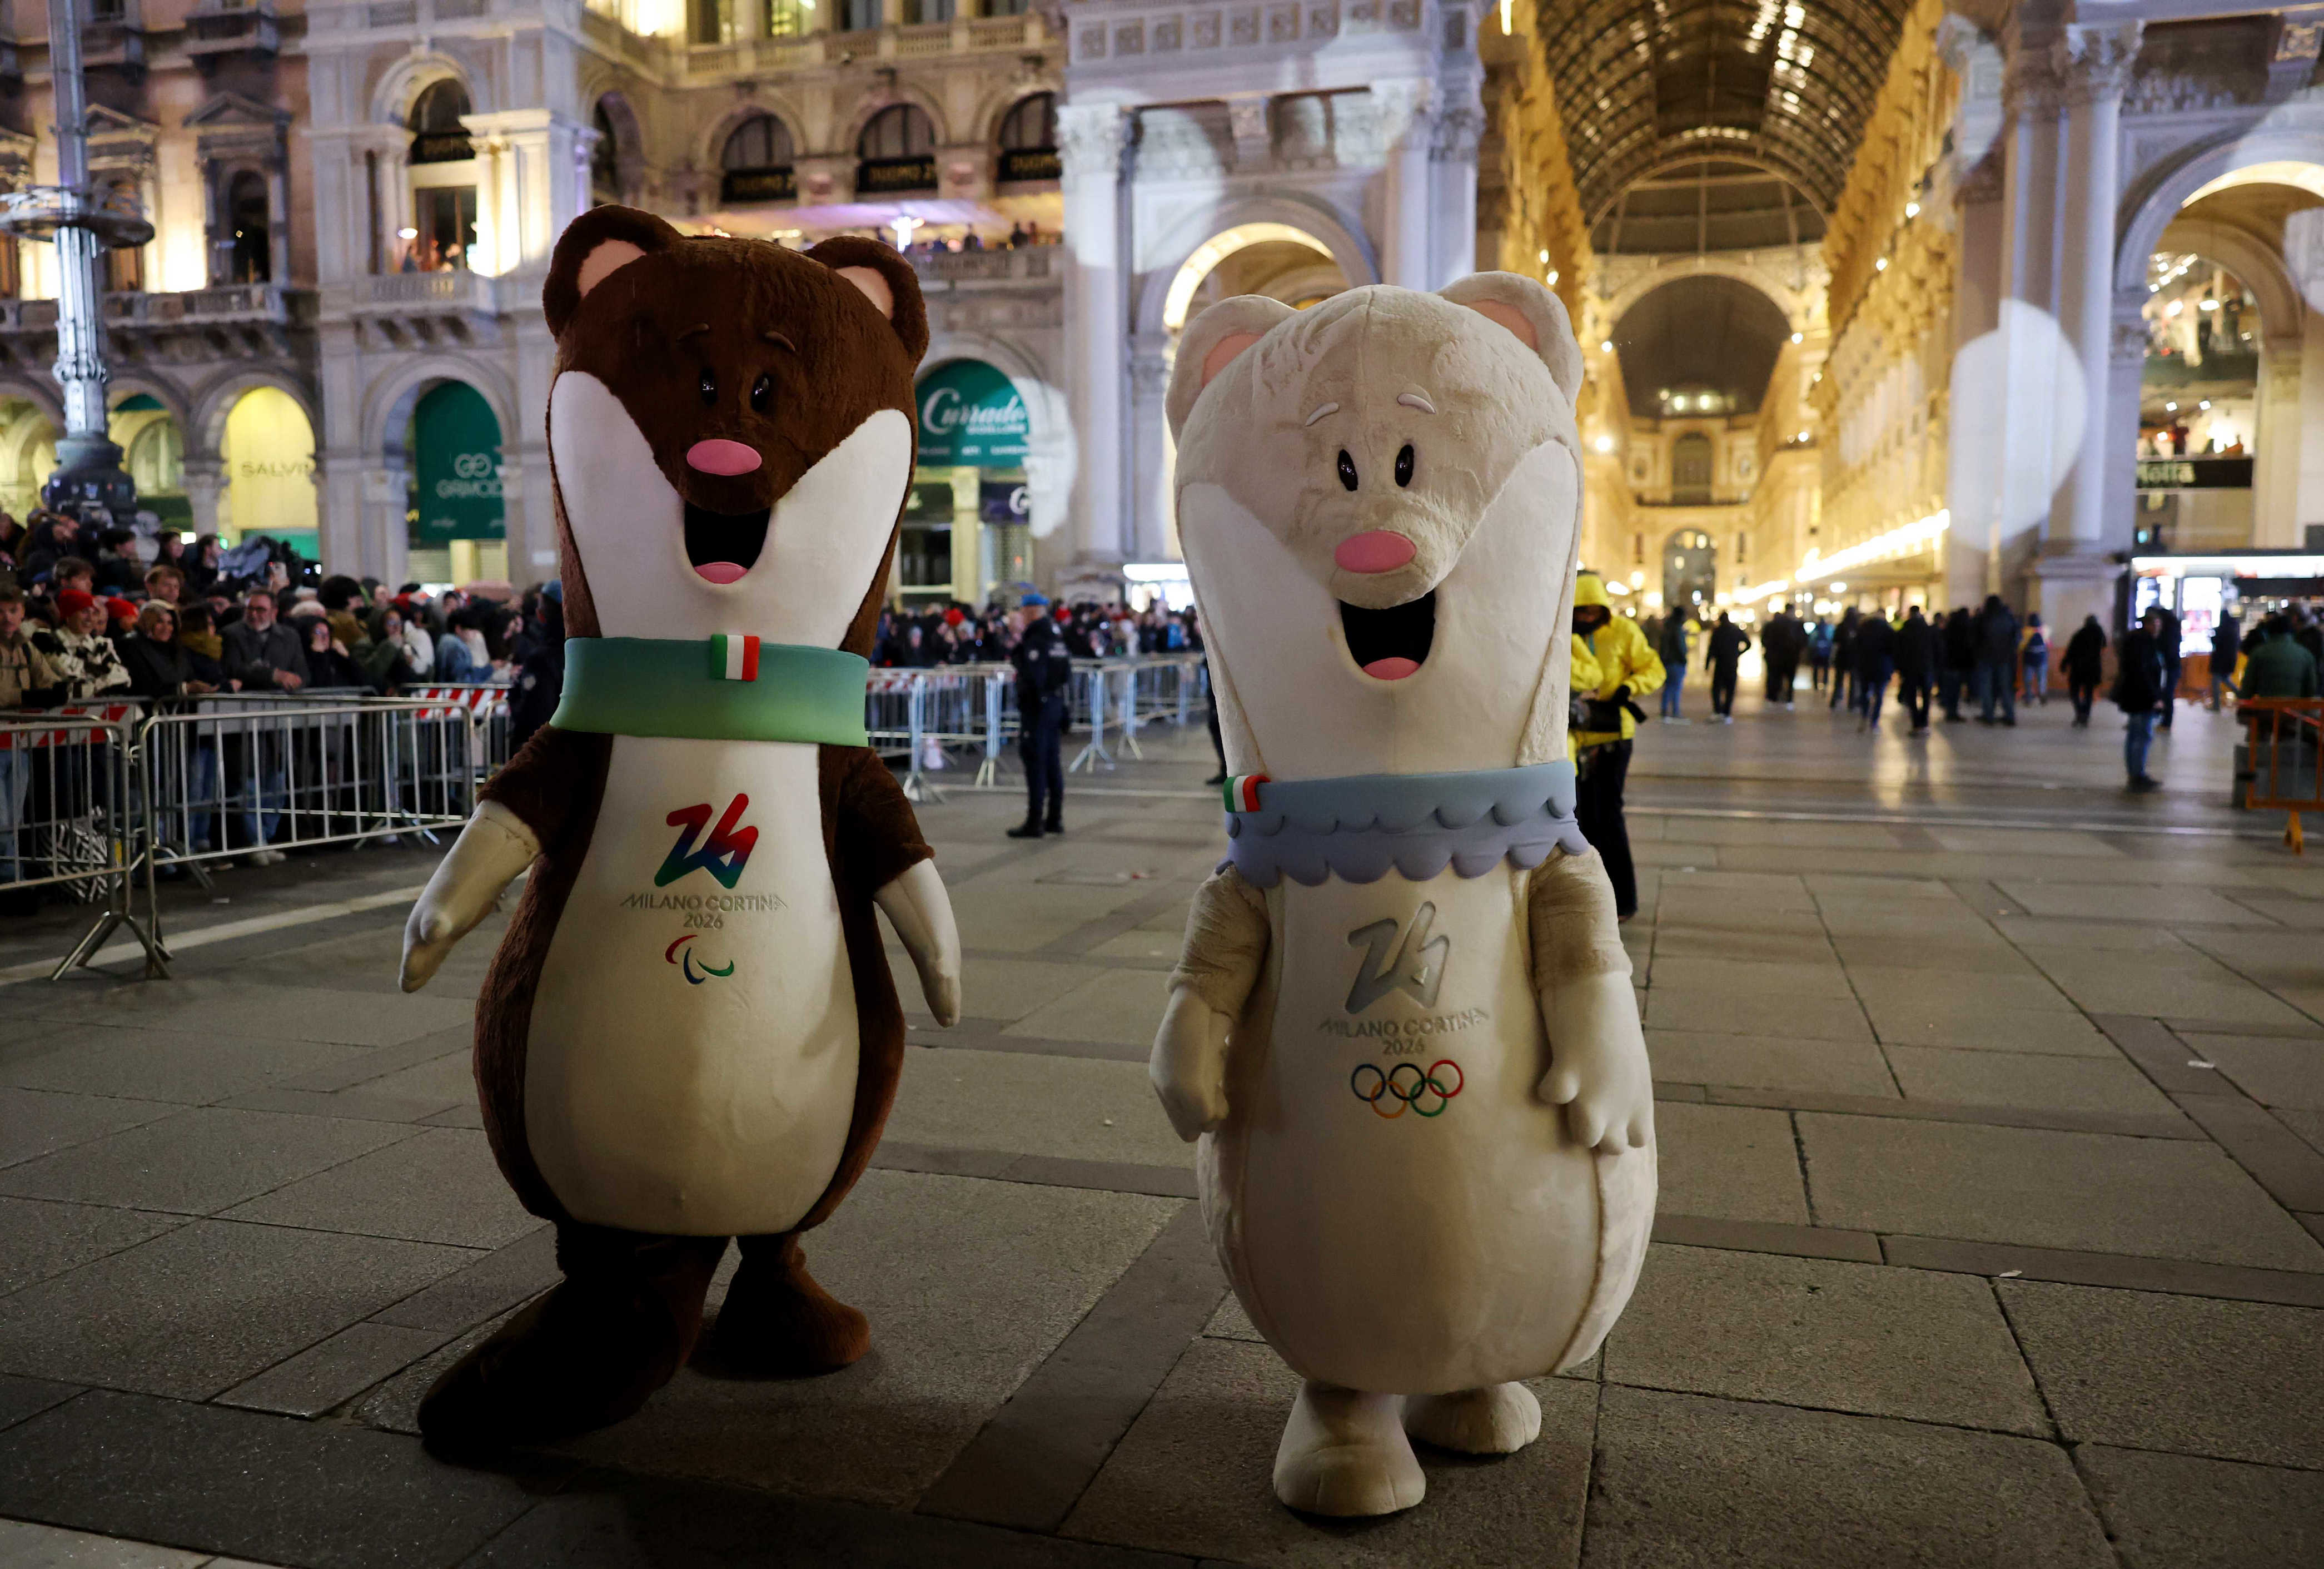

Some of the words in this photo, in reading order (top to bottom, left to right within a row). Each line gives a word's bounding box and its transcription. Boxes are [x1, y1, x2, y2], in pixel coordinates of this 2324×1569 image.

[619, 893, 700, 911] MILANO
[705, 893, 788, 912] CORTINA
[683, 912, 724, 930] 2026
[1317, 1017, 1399, 1039] MILANO
[1403, 1007, 1490, 1036] CORTINA
[1382, 1037, 1426, 1056] 2026
